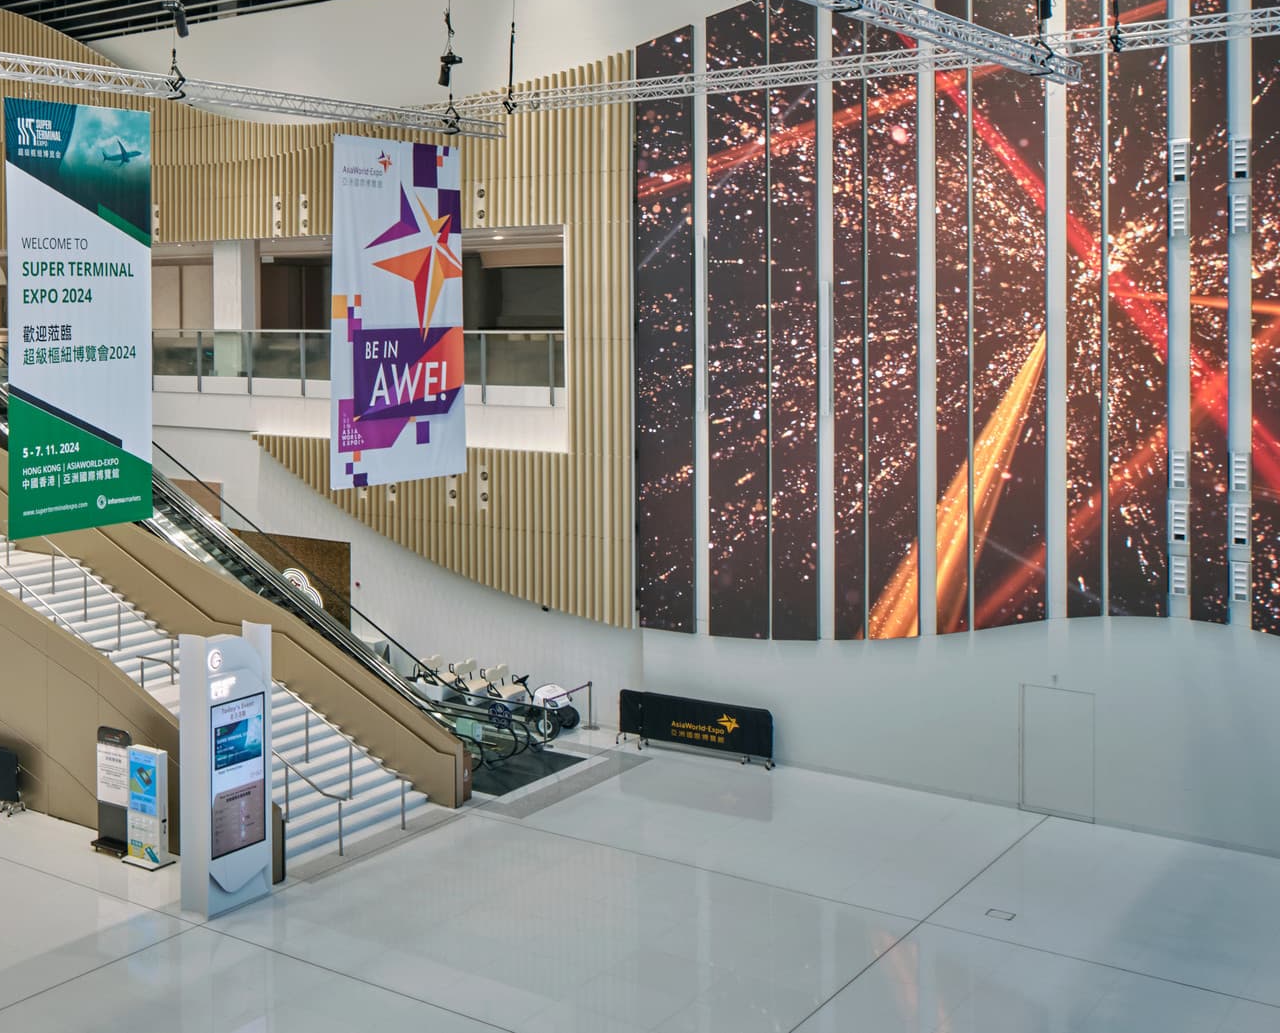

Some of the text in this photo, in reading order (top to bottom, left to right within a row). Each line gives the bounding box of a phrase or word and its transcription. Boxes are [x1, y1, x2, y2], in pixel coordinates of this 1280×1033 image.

[36, 130, 61, 141] TERMINAL
[22, 237, 88, 250] WELCOME TO
[22, 261, 134, 277] SUPER TERMINAL
[23, 288, 92, 304] EXPO 2024
[23, 325, 72, 343] 歡迎蒞臨
[365, 340, 398, 359] BE IN
[369, 361, 447, 407] AWE!
[23, 448, 28, 458] 5
[35, 446, 43, 456] 7.
[46, 444, 58, 455] 11.
[60, 442, 79, 454] 2024
[23, 458, 119, 476] HONG KONG ASIAWORLD-EXPO
[672, 720, 724, 734] AsiaWorld-Expo
